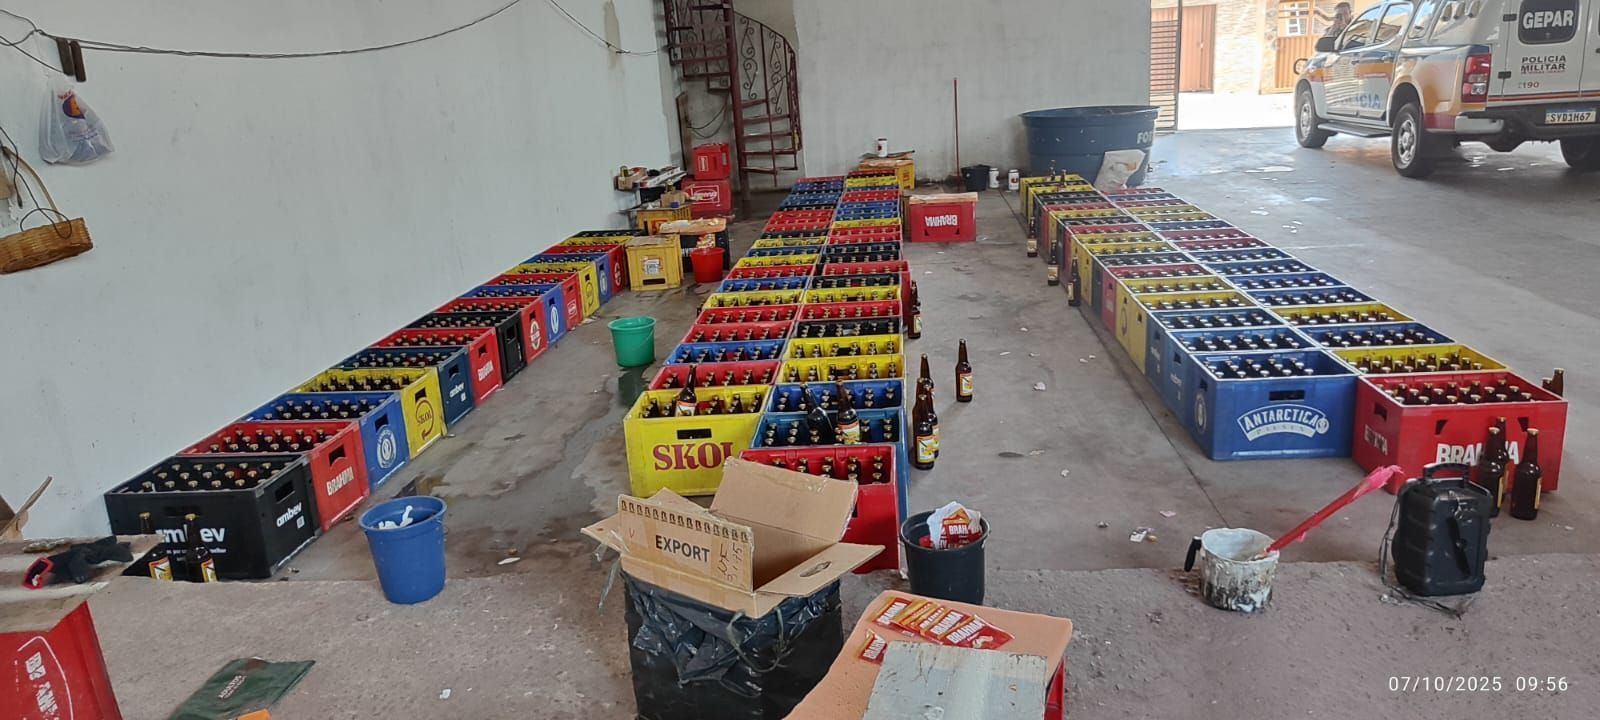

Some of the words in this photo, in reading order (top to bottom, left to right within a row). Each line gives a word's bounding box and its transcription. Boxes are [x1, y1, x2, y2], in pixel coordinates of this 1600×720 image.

[1522, 9, 1574, 29] GEPAR
[1520, 63, 1566, 72] MILITAR
[1243, 408, 1320, 431] ANTARCTICA
[326, 466, 354, 496] BRAHMA
[276, 501, 302, 527] ambev
[655, 534, 710, 563] EXPORT
[929, 611, 964, 635] BRAHMA
[946, 618, 986, 644] BRAHMA
